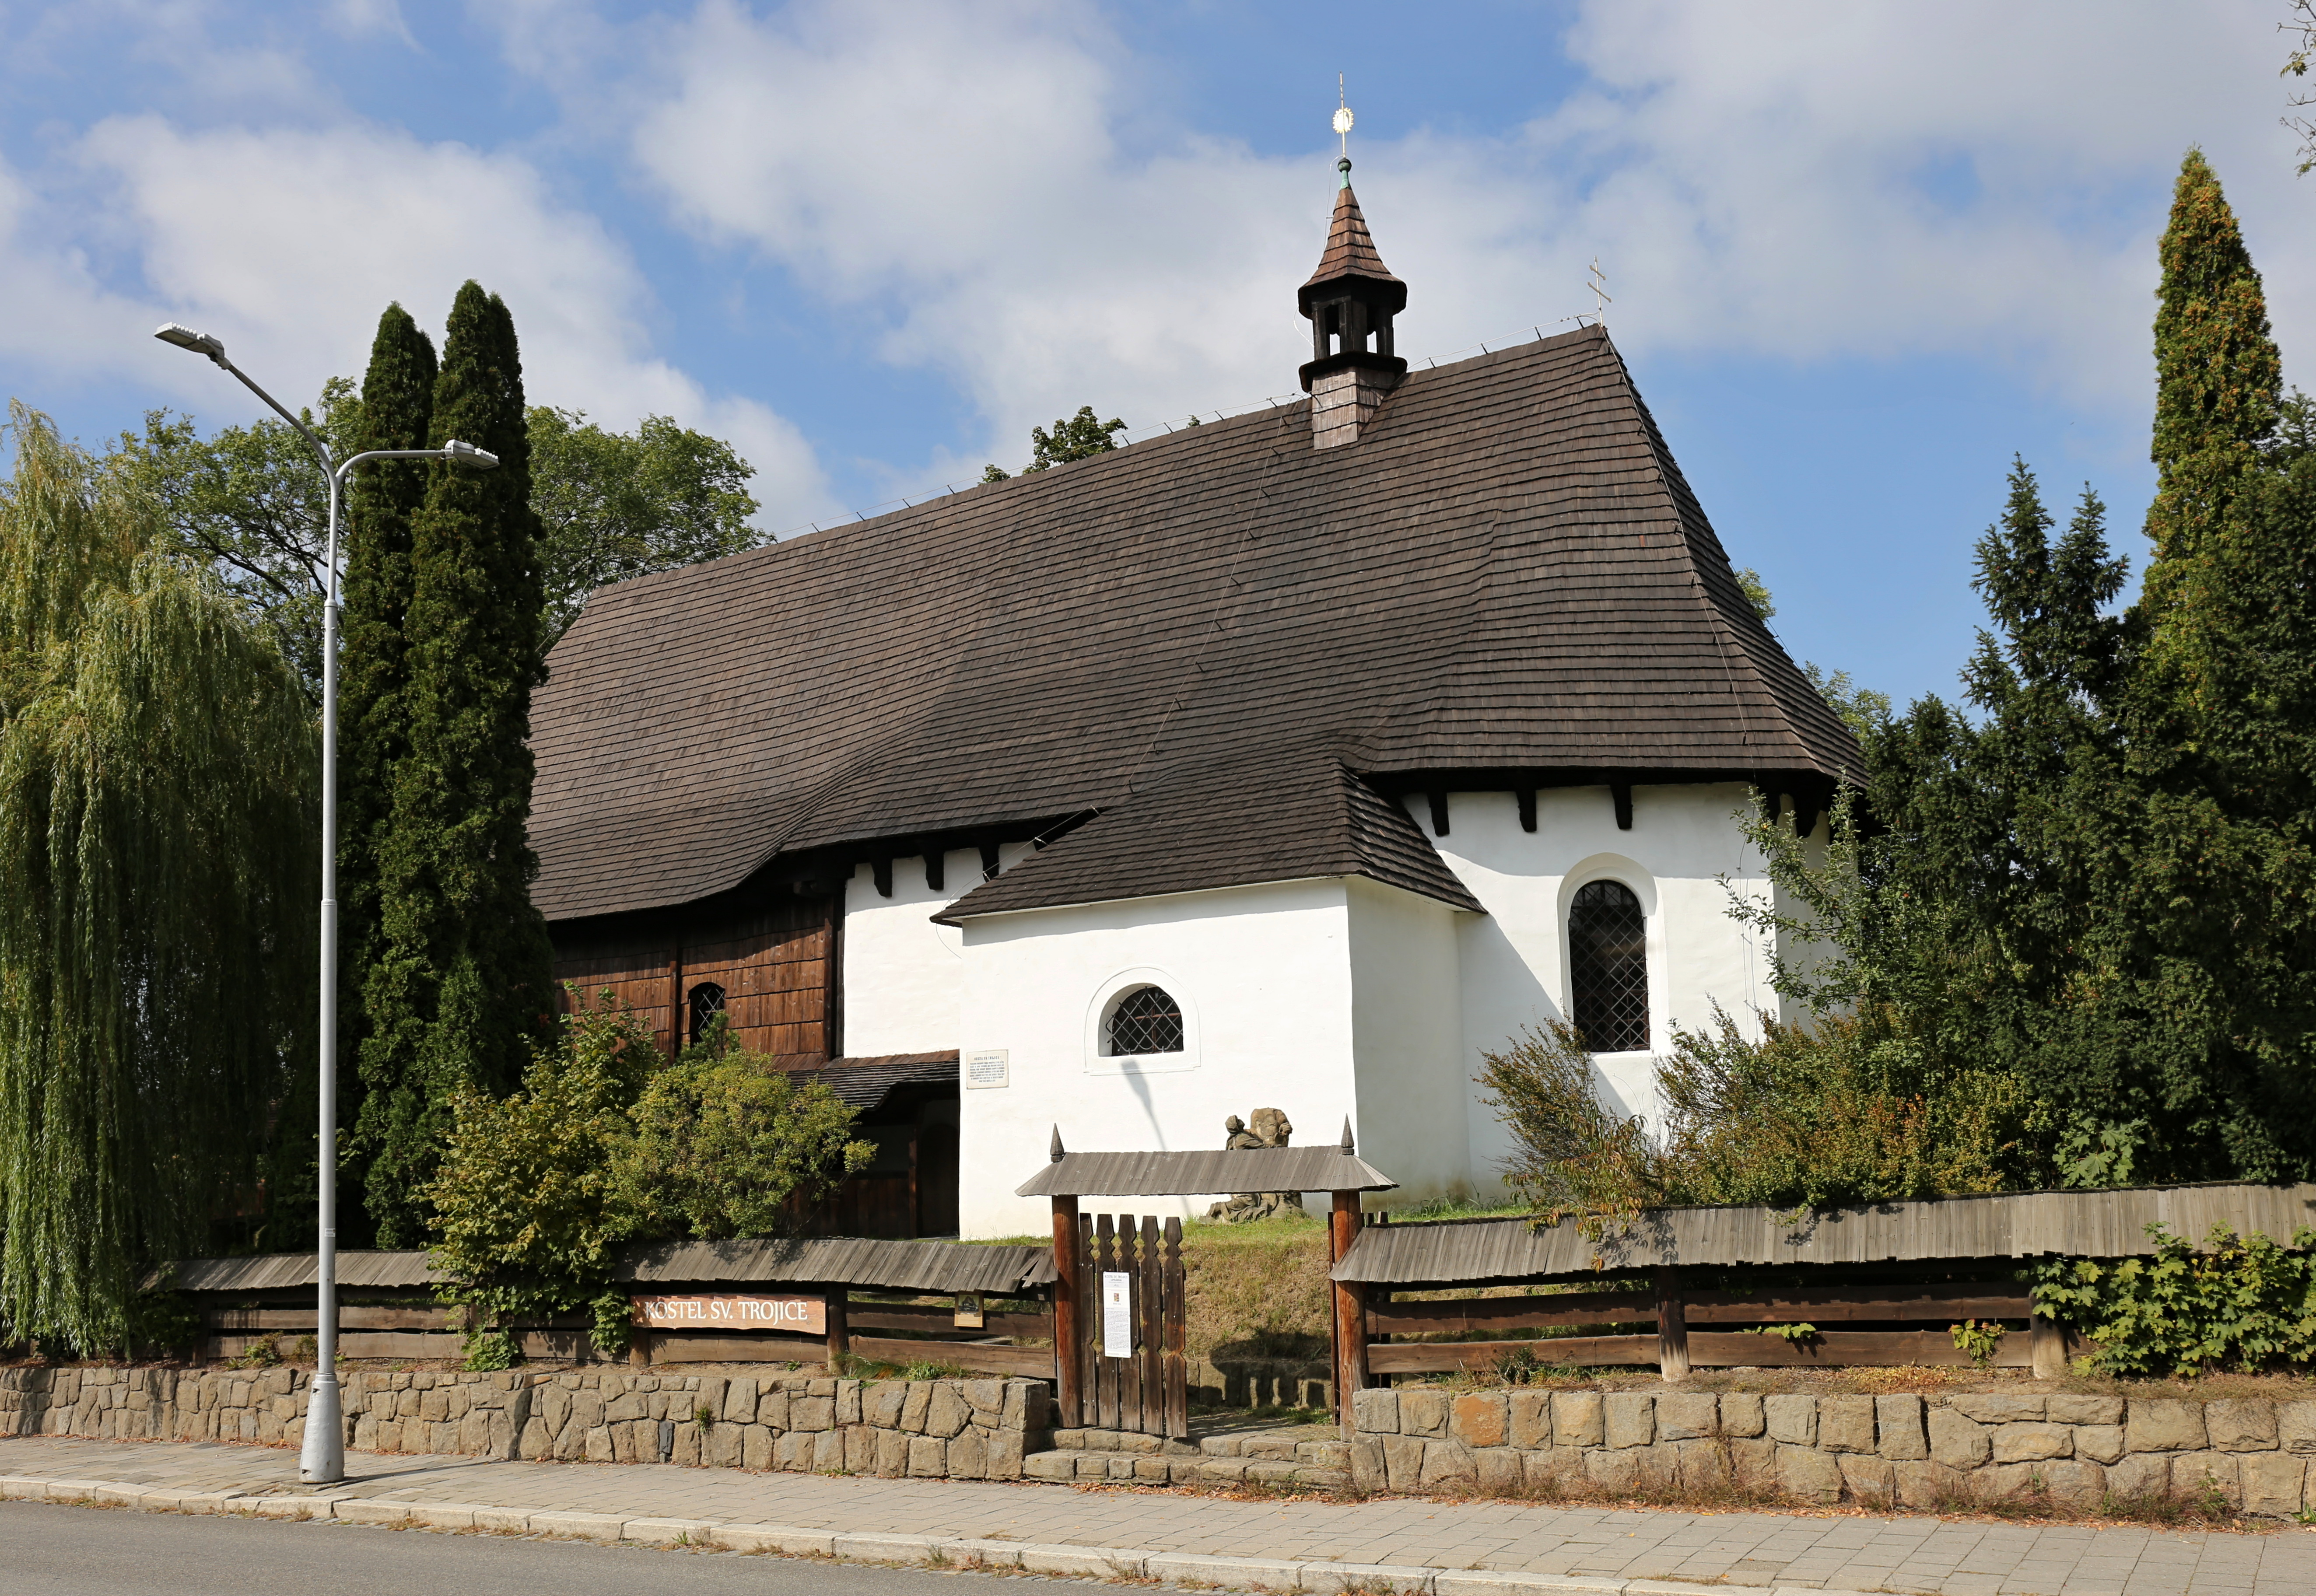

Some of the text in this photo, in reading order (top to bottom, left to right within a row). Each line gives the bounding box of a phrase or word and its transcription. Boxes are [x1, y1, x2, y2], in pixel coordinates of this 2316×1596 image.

[645, 1301, 808, 1326] KOSTEL SV. TROJICE
